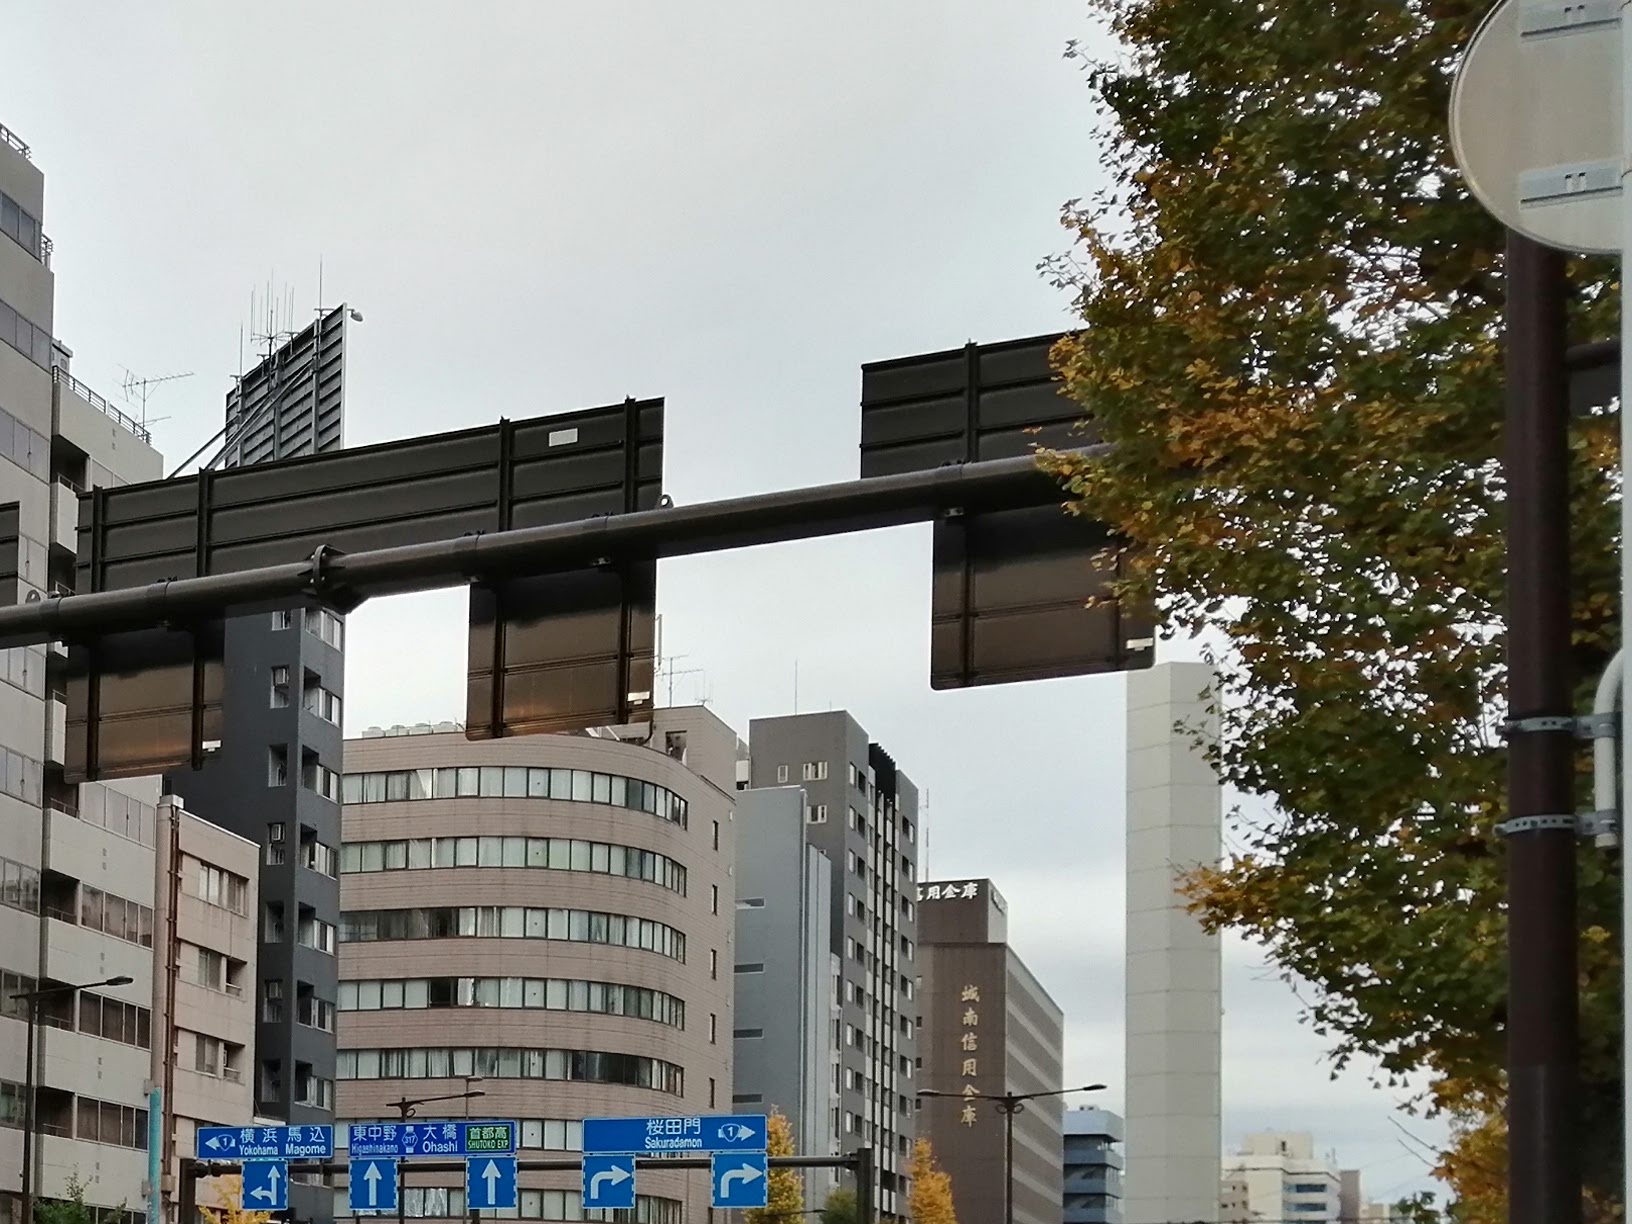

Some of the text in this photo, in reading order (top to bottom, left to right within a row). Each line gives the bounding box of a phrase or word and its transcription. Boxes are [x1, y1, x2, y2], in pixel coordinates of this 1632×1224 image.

[961, 984, 980, 1128] 城南信用金庫
[353, 1125, 397, 1141] 東中野
[423, 1124, 457, 1140] 大橋
[469, 1127, 507, 1139] 首都高
[646, 1118, 702, 1135] 桜田門
[727, 1126, 734, 1137] 1
[239, 1127, 325, 1144] 横浜 馬込
[405, 1135, 415, 1143] 317
[351, 1143, 399, 1155] Higashinakano
[422, 1141, 458, 1153] Ohashi
[468, 1139, 508, 1149] SHUTOKO EXP
[644, 1136, 703, 1149] Sakuradamon
[239, 1143, 326, 1157] Yokohama Magome
